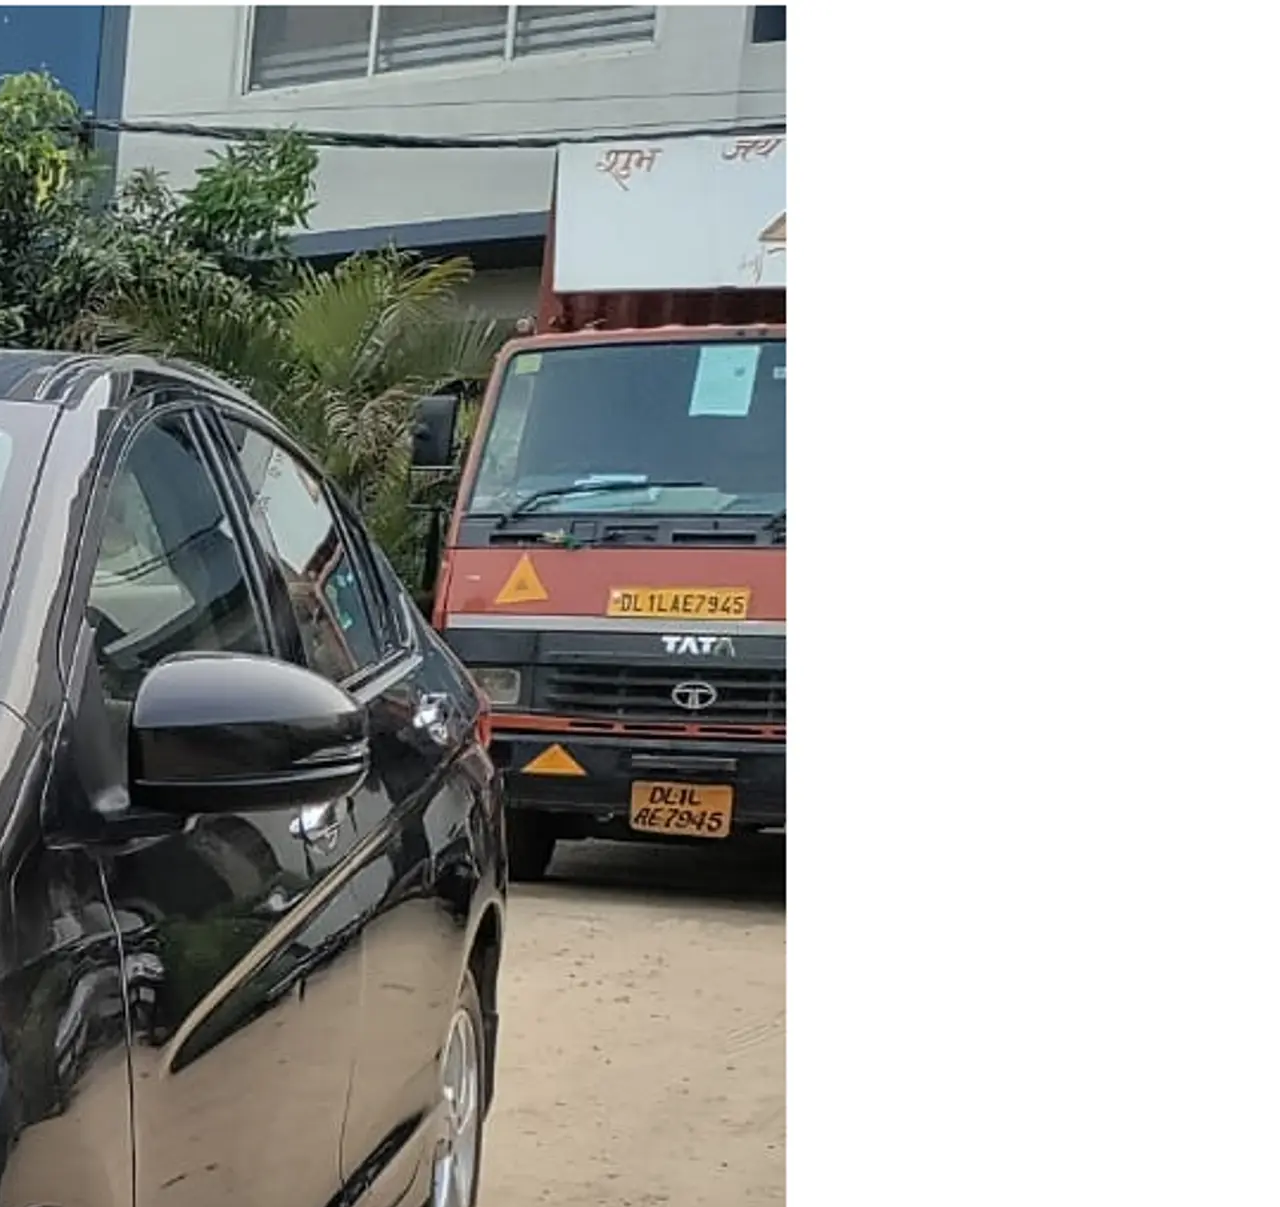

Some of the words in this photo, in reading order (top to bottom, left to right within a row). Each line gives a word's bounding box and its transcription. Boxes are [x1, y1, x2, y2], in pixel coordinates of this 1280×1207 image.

[620, 592, 746, 614] DL1LAE7945
[660, 635, 736, 657] TATA
[633, 806, 724, 833] AE7945
